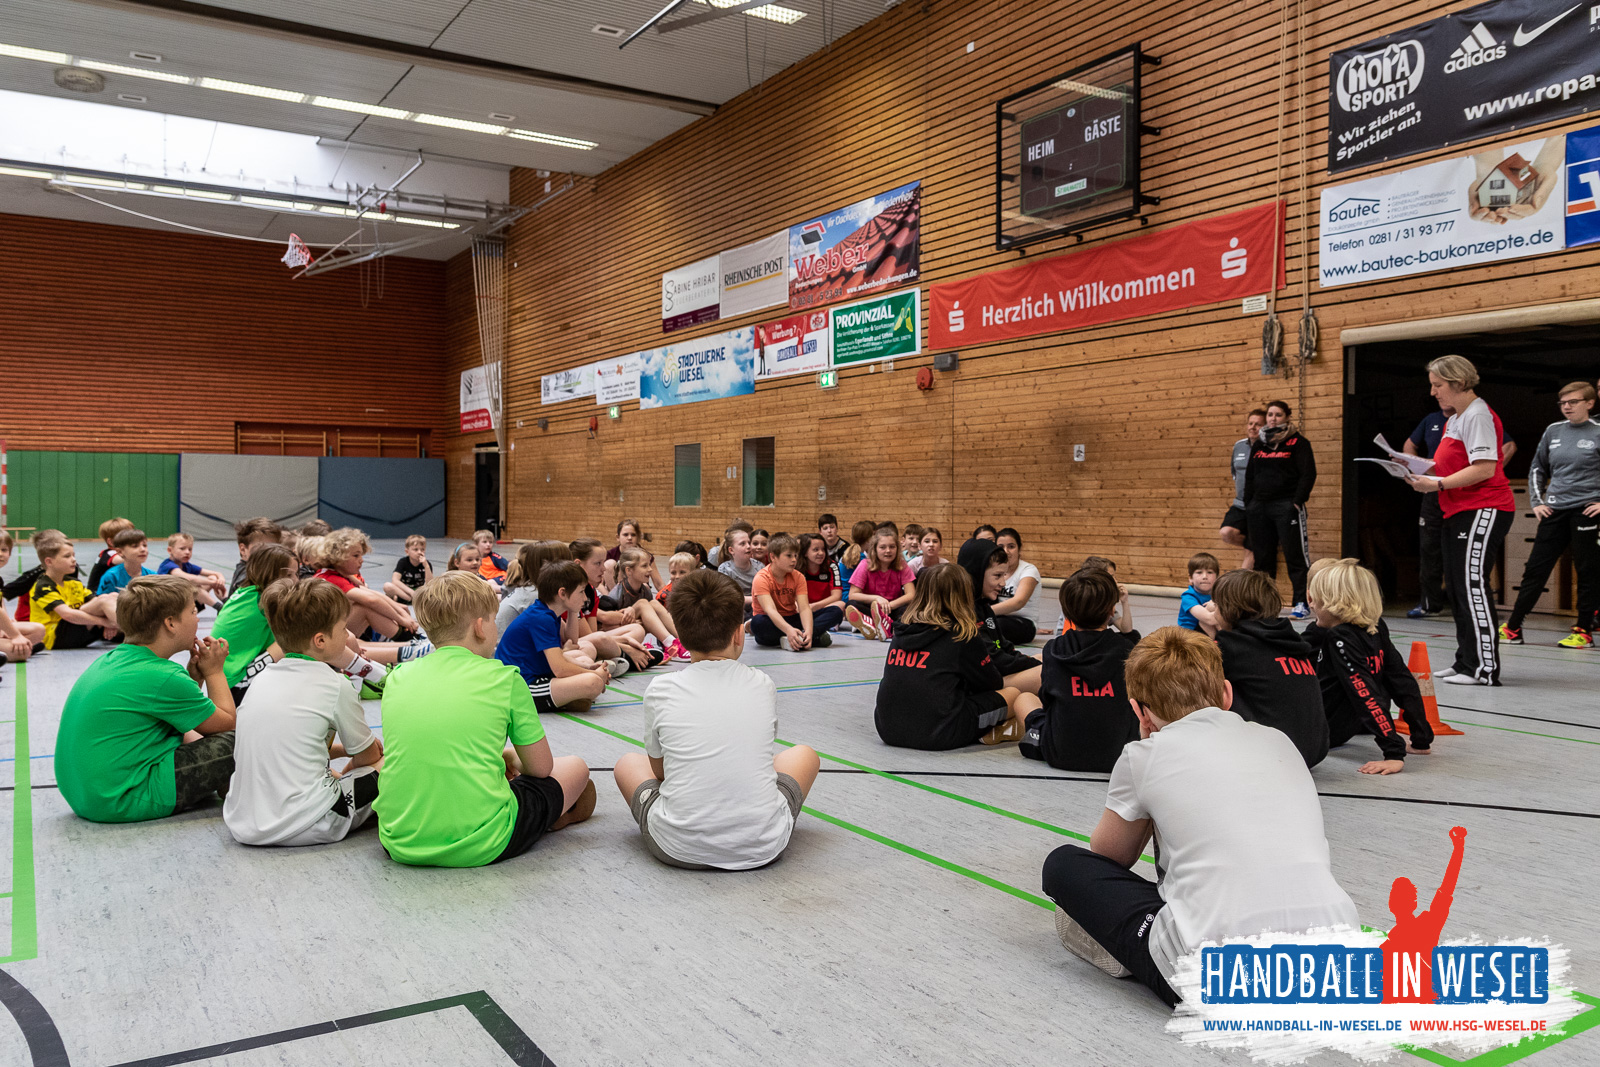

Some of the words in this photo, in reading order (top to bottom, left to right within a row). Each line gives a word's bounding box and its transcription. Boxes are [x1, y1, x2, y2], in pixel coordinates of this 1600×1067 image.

[1443, 44, 1507, 74] adidas
[1351, 80, 1410, 112] SPORT
[1084, 115, 1121, 142] GÄSTE
[1336, 125, 1394, 161] Sportler
[1397, 111, 1422, 132] an!
[1338, 125, 1365, 145] Wir
[1368, 101, 1416, 132] ziehen
[1028, 139, 1055, 162] HEIM
[1329, 203, 1380, 222] bautec
[1328, 239, 1364, 252] Telefon
[1369, 232, 1391, 245] 0281
[1403, 228, 1414, 239] 31
[1419, 224, 1433, 236] 93
[1435, 220, 1455, 233] 777
[793, 243, 869, 281] Weber
[1323, 229, 1554, 279] www.bautec-baukonzepte.de
[724, 264, 762, 286] RHEINISCHE
[764, 256, 783, 275] POST
[846, 269, 918, 294] www.weberbedachungen.de
[982, 293, 1055, 328] Herzlich
[1059, 267, 1195, 313] Willkommen
[836, 305, 895, 329] PROVINZIAL
[677, 347, 726, 369] STADTWERKE
[679, 369, 704, 383] WESEL
[888, 649, 930, 668] CRUZ
[1071, 677, 1114, 697] ELA
[1350, 673, 1370, 697] HSG
[1365, 697, 1392, 737] WESEL
[1137, 921, 1149, 937] JAKO
